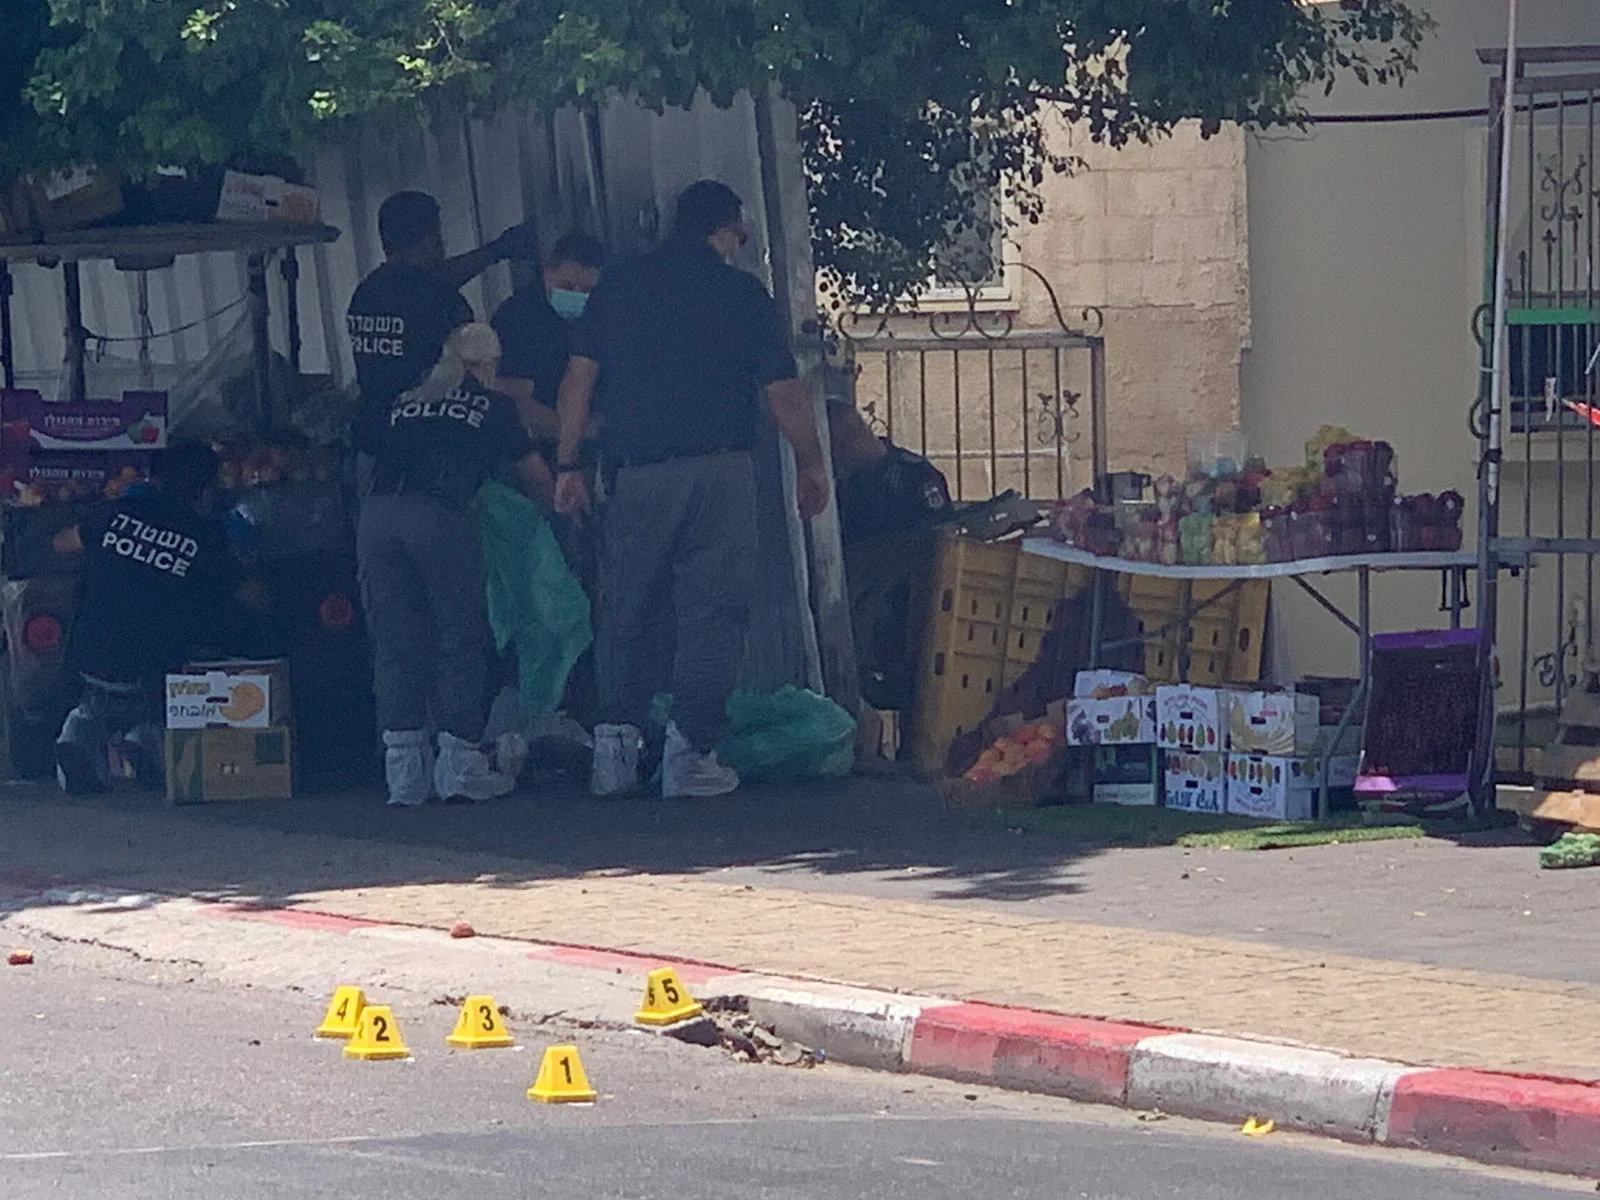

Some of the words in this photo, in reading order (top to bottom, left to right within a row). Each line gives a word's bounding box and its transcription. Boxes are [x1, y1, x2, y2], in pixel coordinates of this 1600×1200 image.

[110, 513, 198, 557] משטרה
[102, 531, 190, 577] POLICE
[661, 977, 680, 1004] 5
[336, 997, 350, 1022] 4
[479, 1005, 494, 1032] 3
[373, 1015, 390, 1042] 2
[559, 1056, 572, 1084] 1
